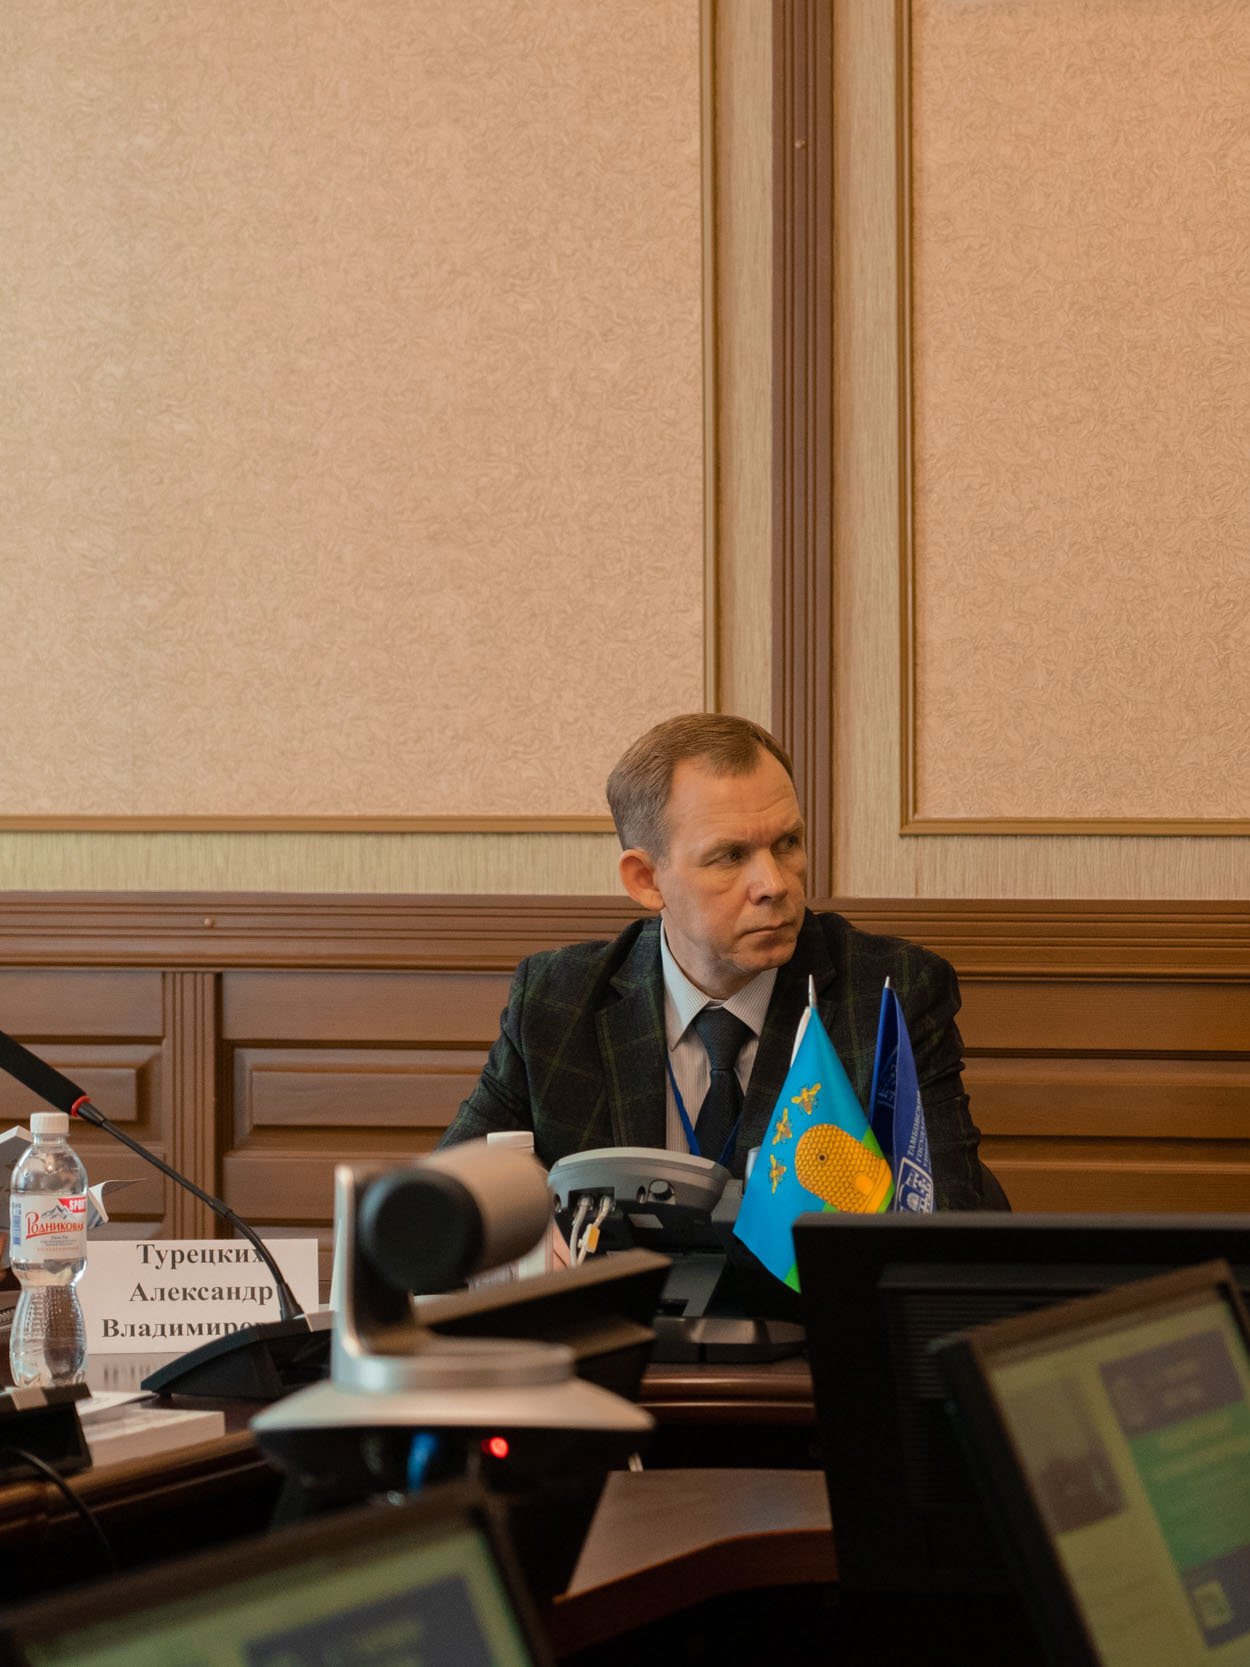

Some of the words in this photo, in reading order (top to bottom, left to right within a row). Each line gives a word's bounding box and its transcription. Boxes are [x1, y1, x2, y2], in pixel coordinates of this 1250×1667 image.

[136, 1243, 264, 1270] Турецких
[129, 1282, 274, 1306] Александр
[102, 1318, 264, 1338] Владимиро
